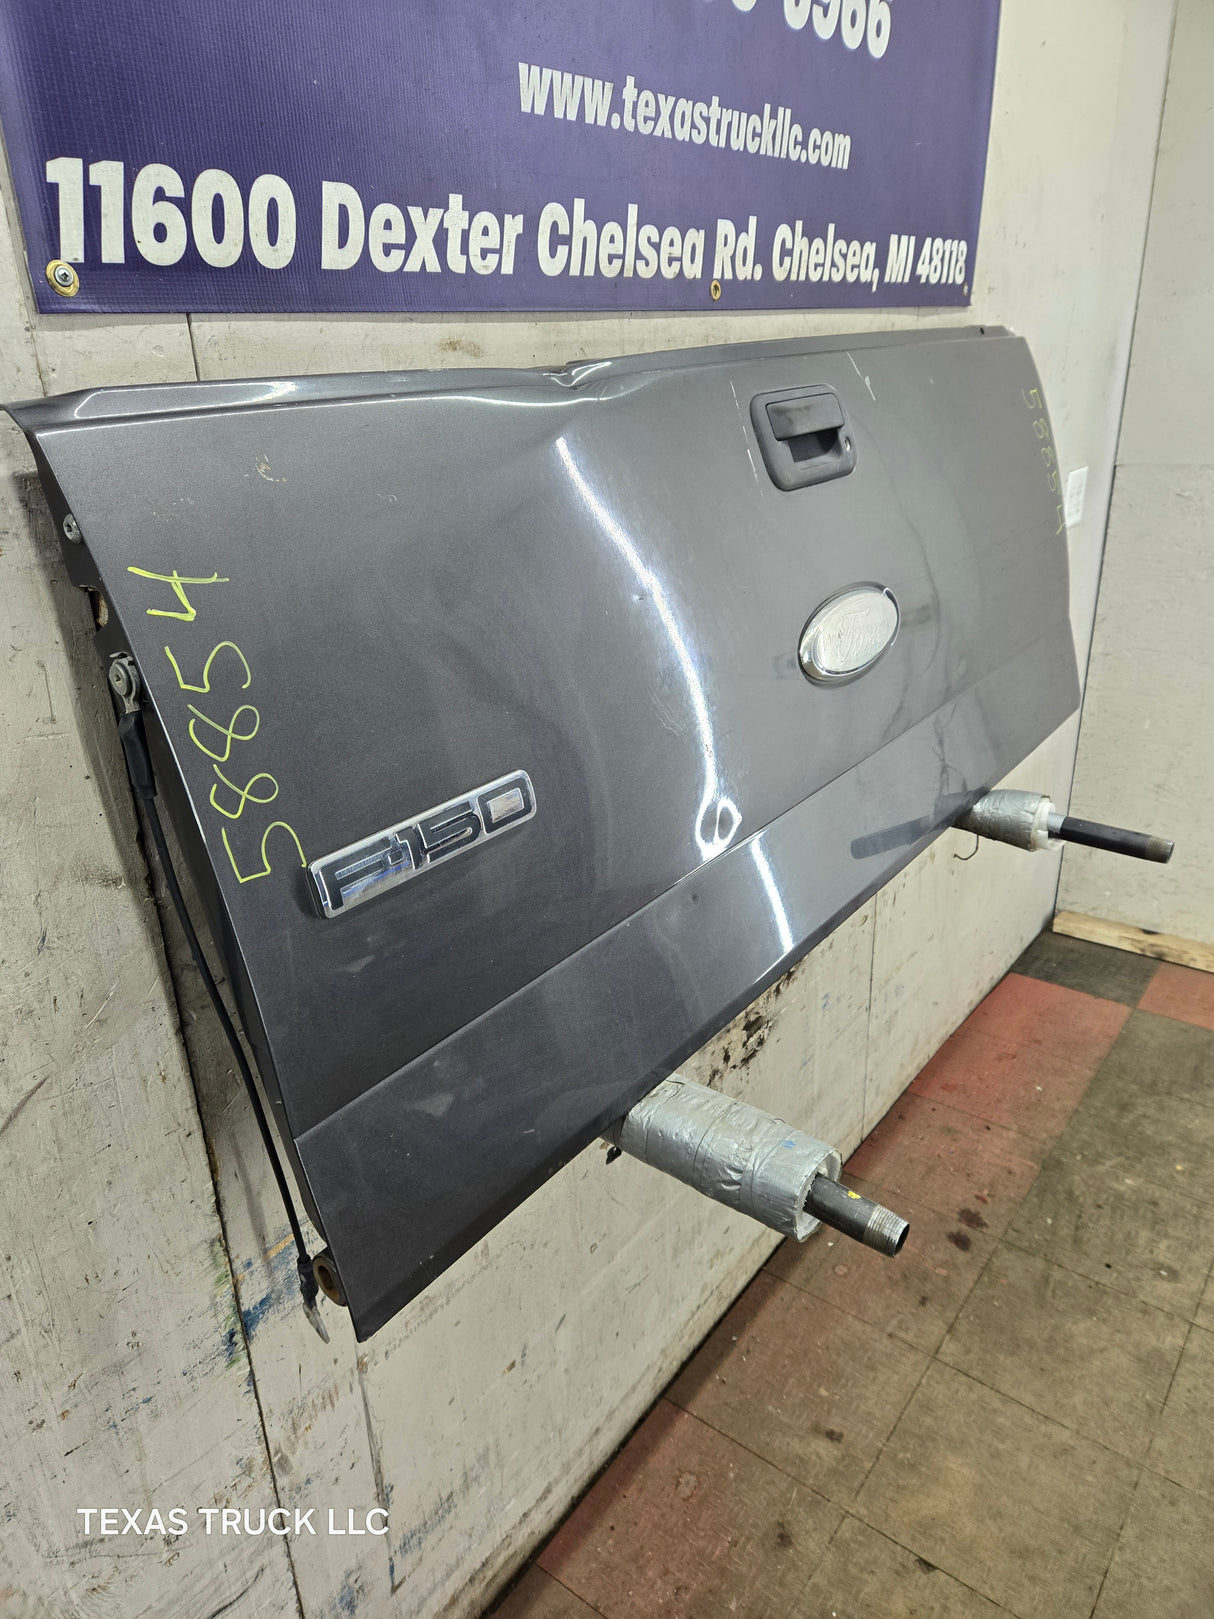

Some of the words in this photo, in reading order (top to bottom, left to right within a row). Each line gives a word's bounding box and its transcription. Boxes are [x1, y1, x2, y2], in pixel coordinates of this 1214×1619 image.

[518, 62, 852, 170] www.texastruckllc.com
[45, 156, 297, 270] 11600
[321, 181, 523, 275] Dexter
[537, 197, 705, 280] Chelsea
[713, 216, 763, 281] Rd.
[772, 220, 879, 292] Chelsea,
[884, 234, 916, 284] MI
[916, 237, 968, 285] 48118
[316, 772, 533, 913] F-150
